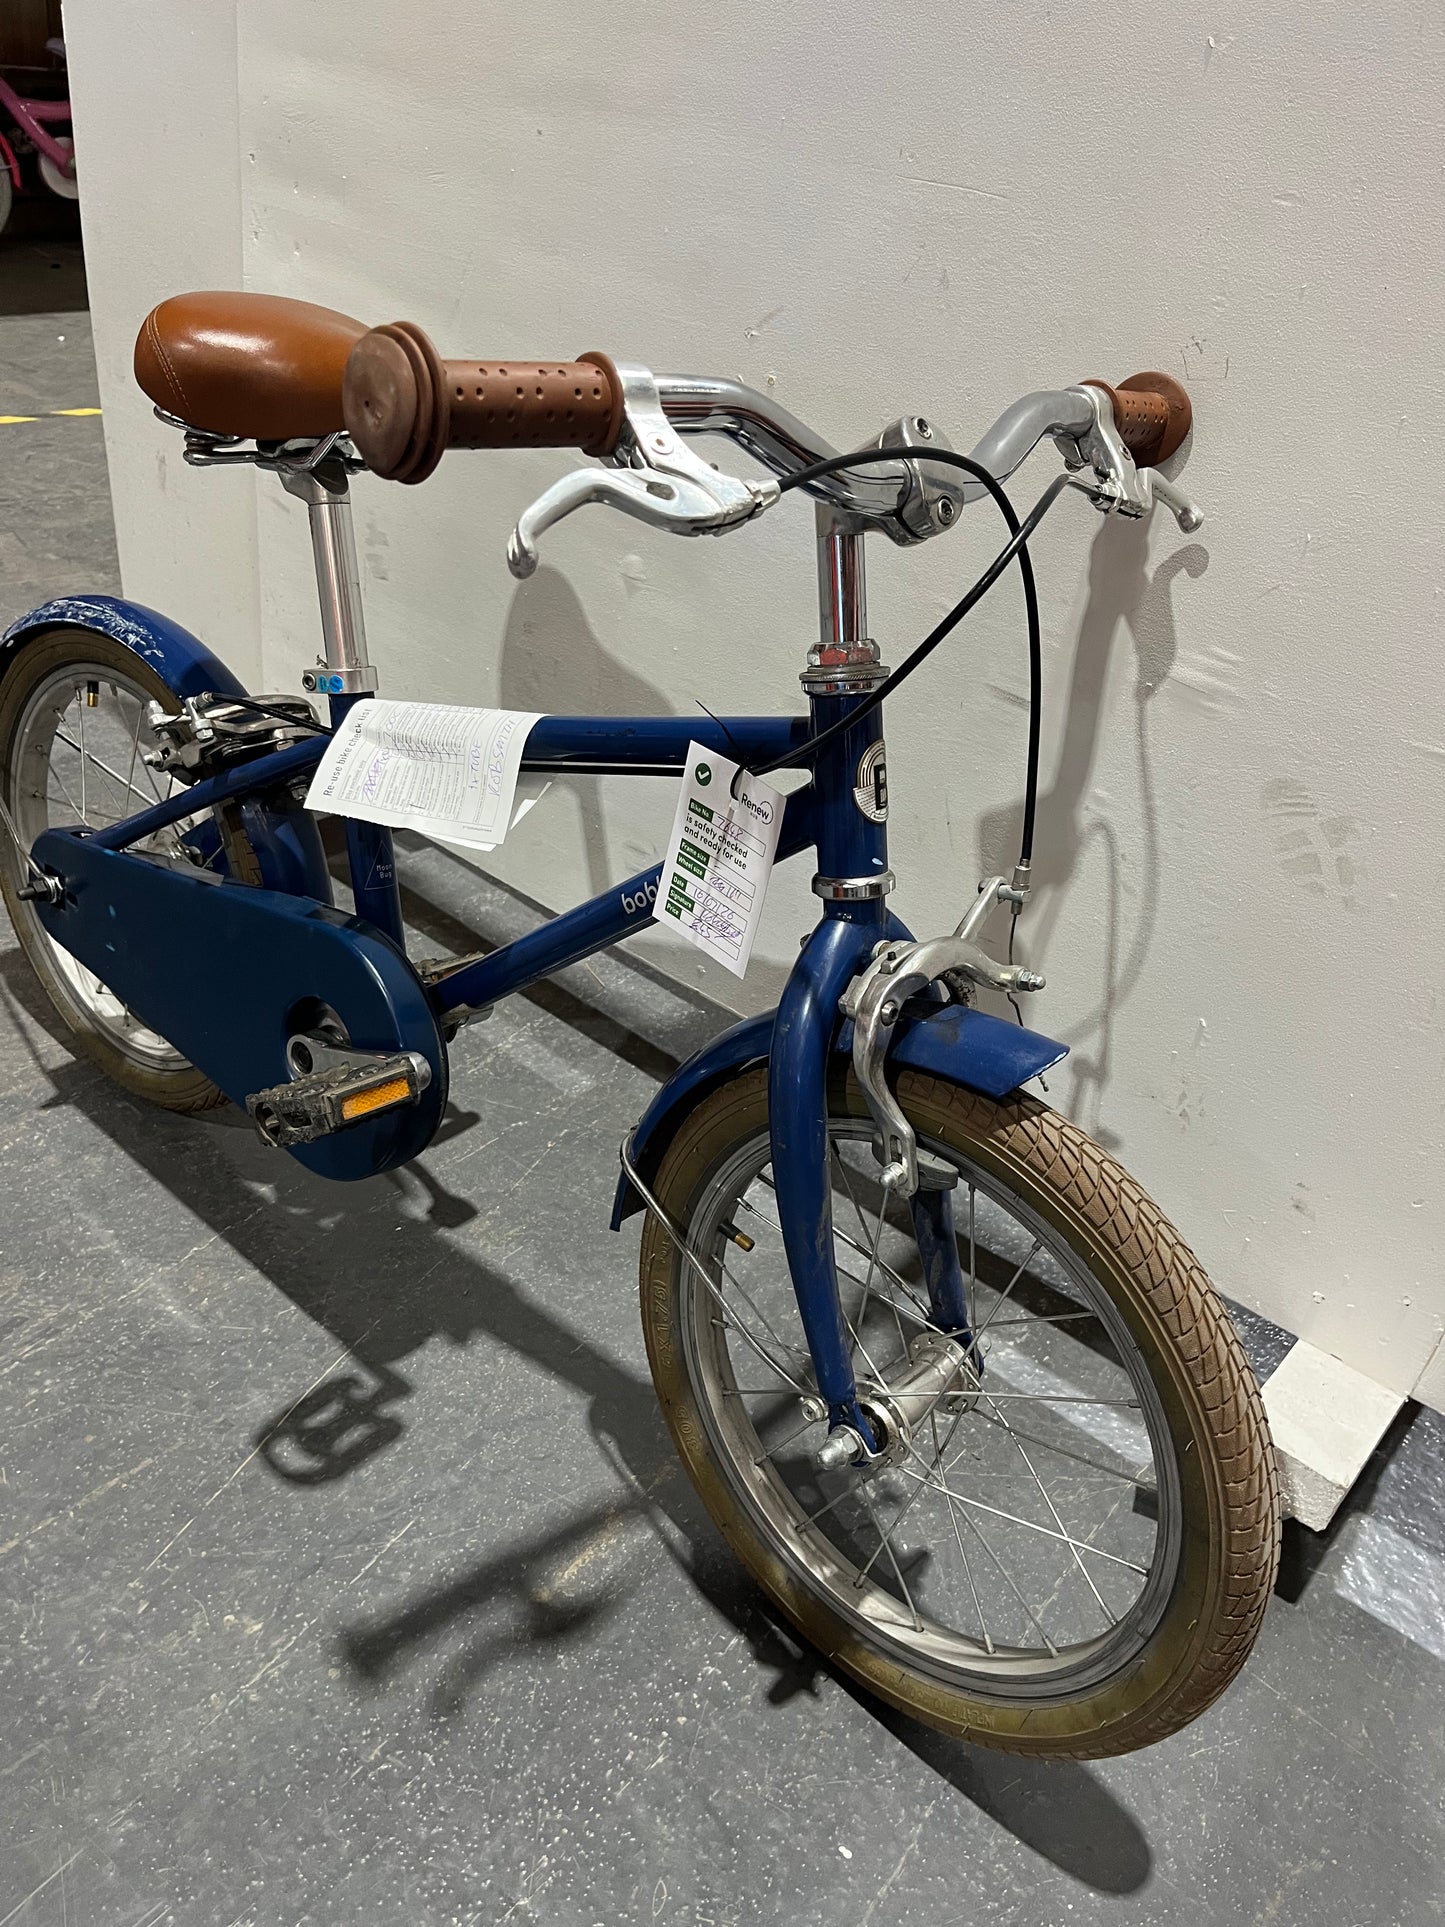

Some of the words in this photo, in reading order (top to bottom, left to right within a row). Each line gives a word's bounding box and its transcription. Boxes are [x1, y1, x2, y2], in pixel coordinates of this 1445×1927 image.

[323, 766, 343, 797] Re-use
[336, 747, 353, 766] bike
[348, 721, 364, 747] check
[740, 792, 770, 820] Renew
[686, 812, 693, 824] is
[693, 819, 718, 841] safety
[717, 833, 749, 859] checked
[680, 841, 697, 857] Frame
[696, 851, 708, 863] size
[684, 825, 699, 839] and
[699, 834, 722, 855] ready
[721, 846, 734, 861] for
[733, 856, 747, 870] use
[678, 854, 694, 871] Wheel
[692, 865, 703, 877] size
[673, 876, 686, 889] Date
[666, 903, 680, 917] Price
[669, 889, 692, 909] Signature
